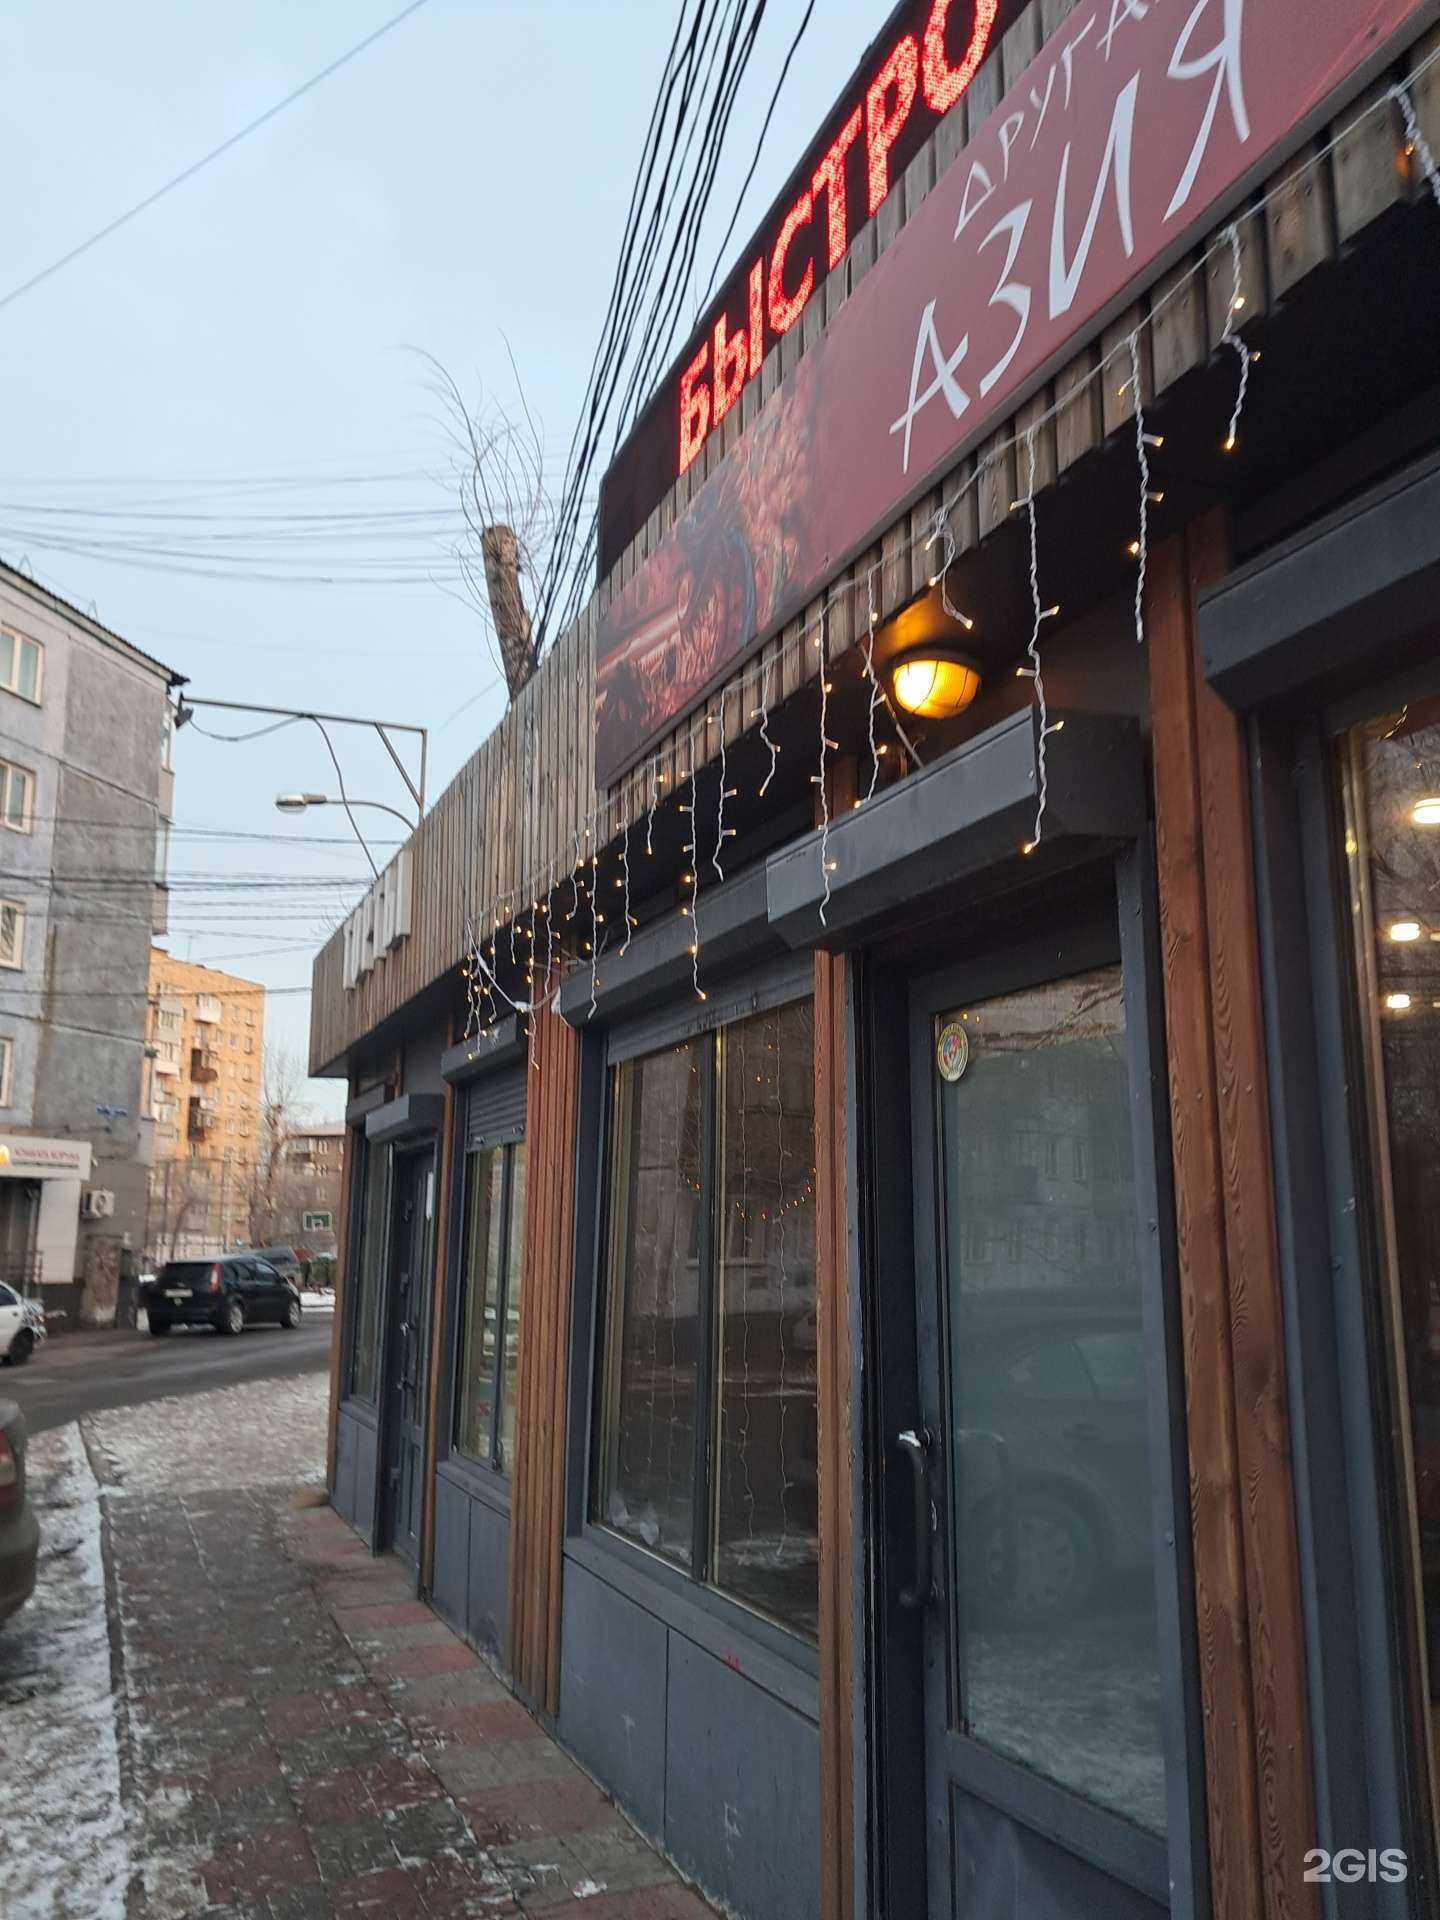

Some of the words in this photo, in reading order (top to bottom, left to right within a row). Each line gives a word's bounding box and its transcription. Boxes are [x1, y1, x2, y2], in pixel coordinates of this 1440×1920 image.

[679, 0, 998, 477] БЫСТРО
[889, 0, 1250, 474] АЗИЯ
[953, 0, 1159, 242] ДРУГА
